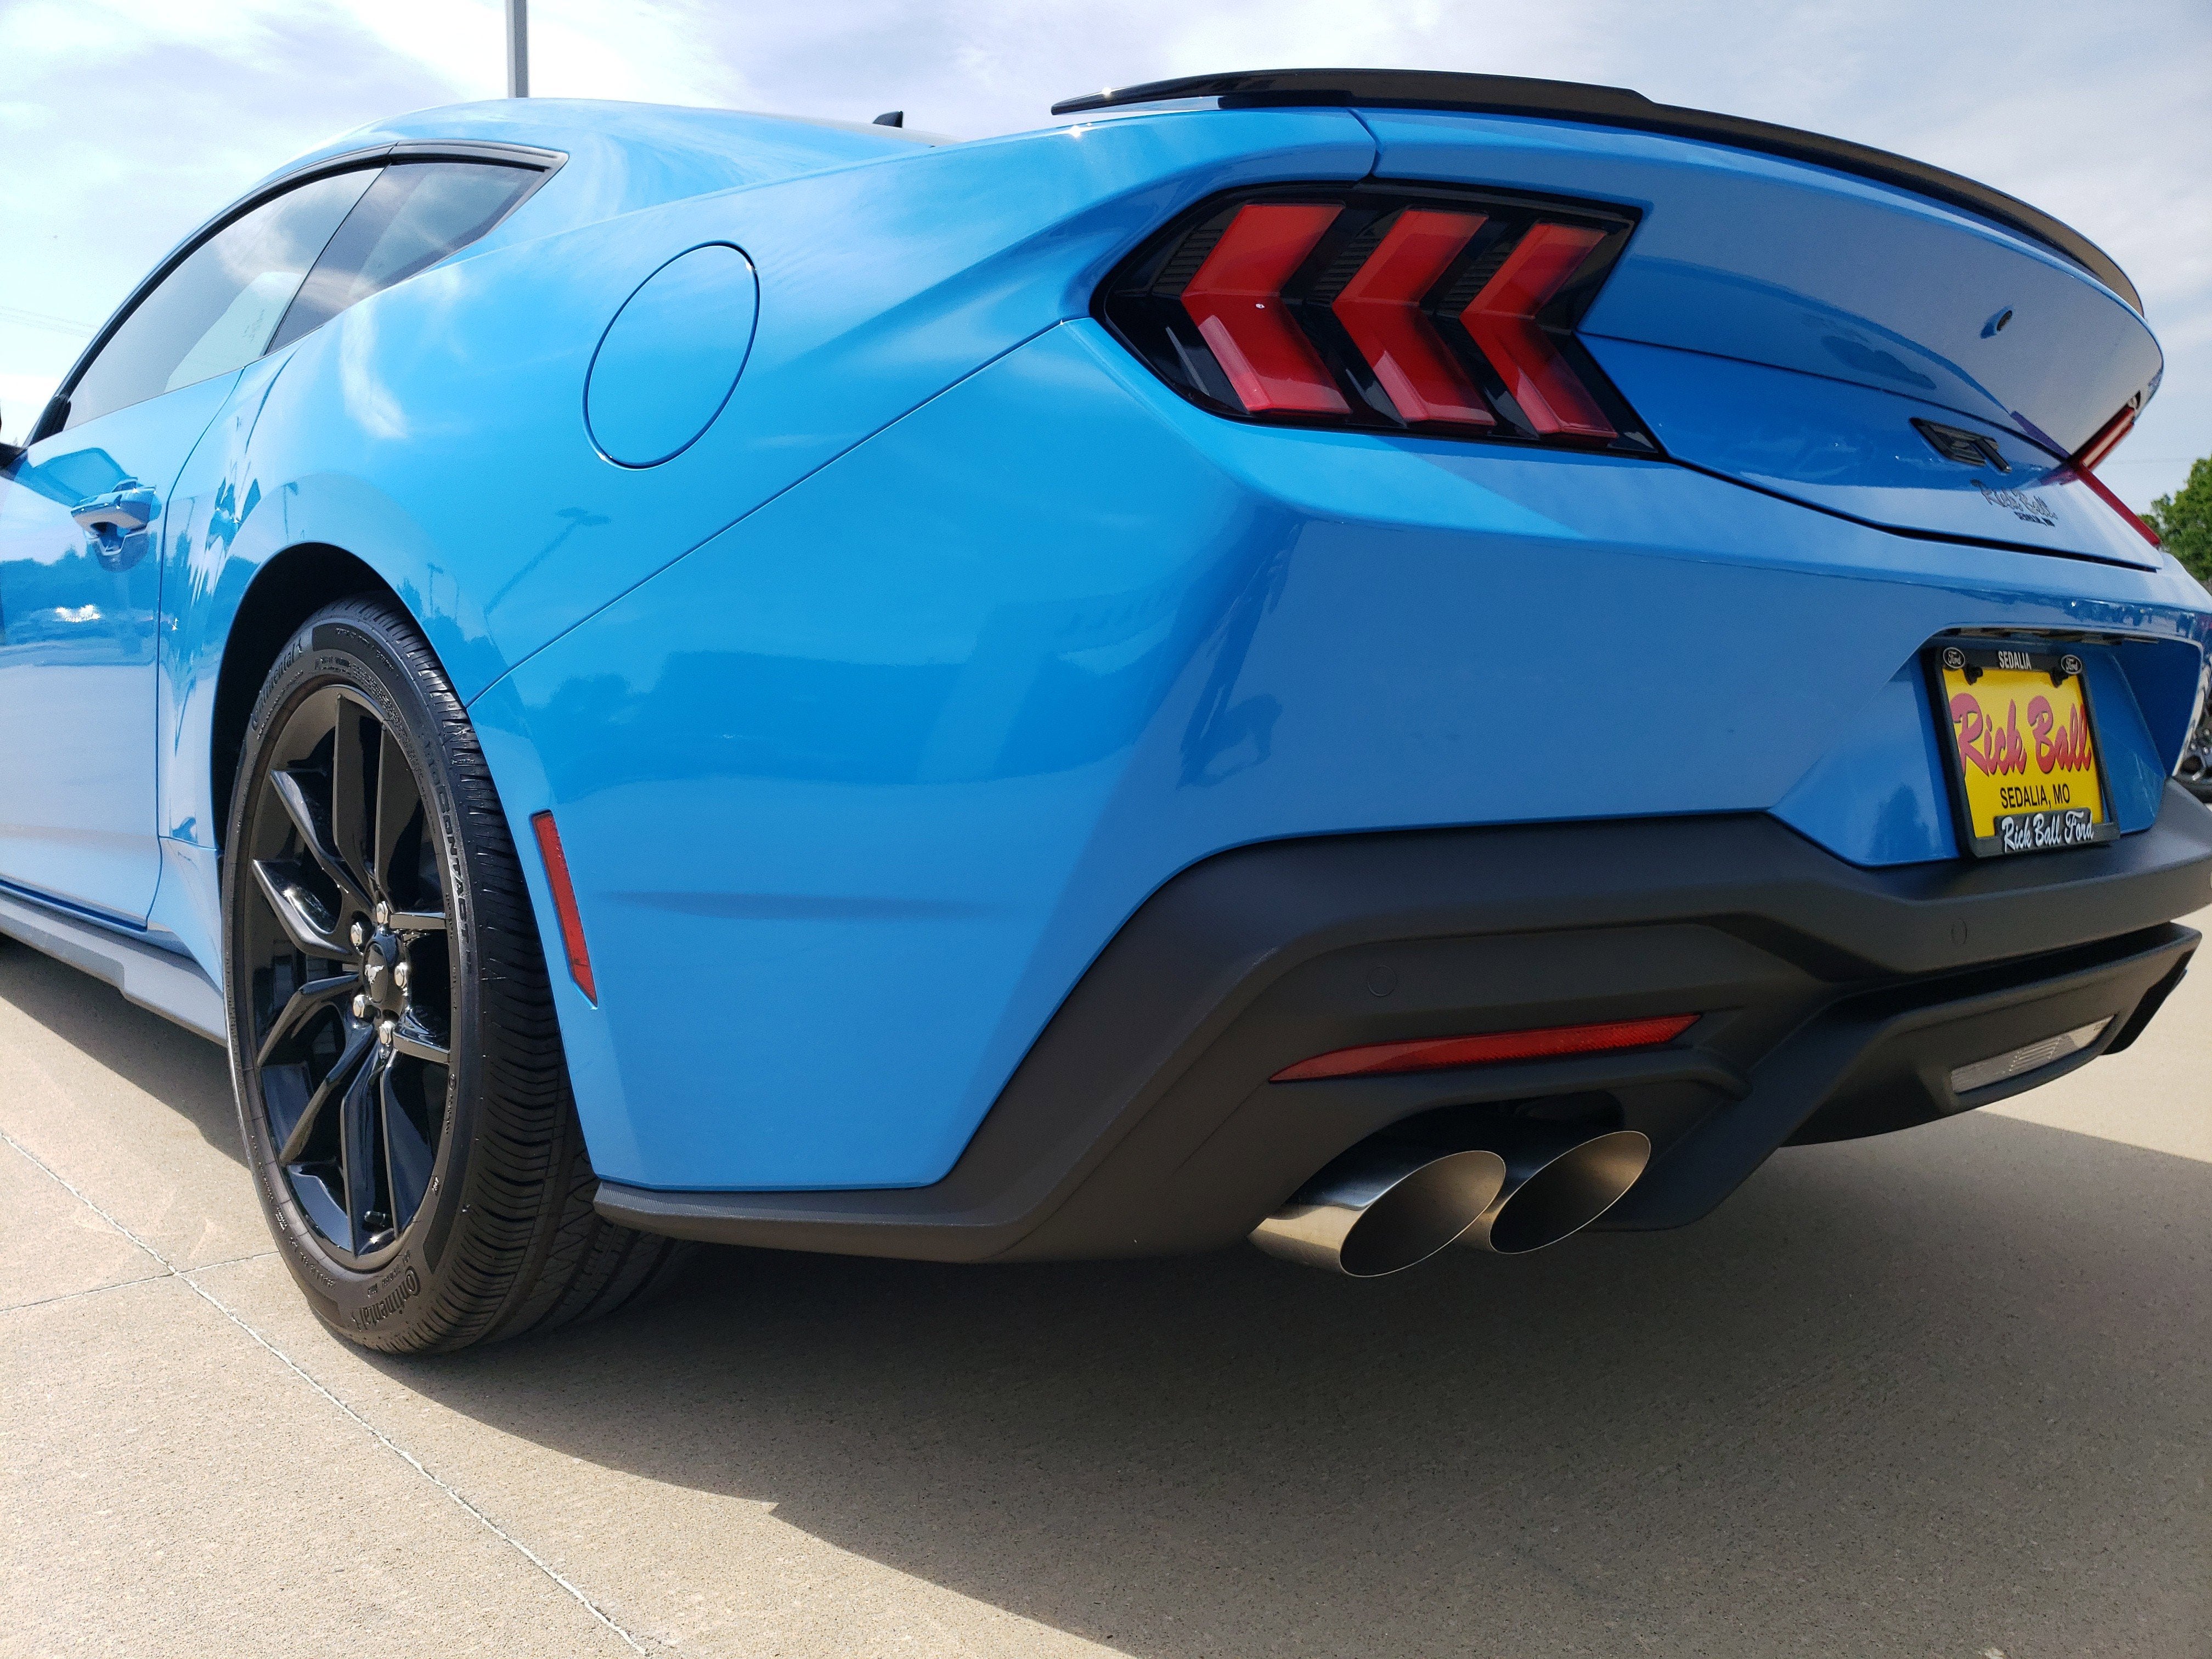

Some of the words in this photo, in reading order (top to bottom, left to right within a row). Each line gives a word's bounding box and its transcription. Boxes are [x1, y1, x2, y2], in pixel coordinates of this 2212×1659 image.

[1997, 650, 2032, 670] SEDALIA
[1949, 692, 2027, 777] Rick
[2027, 695, 2092, 775] Ball
[2000, 785, 2051, 810] SEDALIA,
[2053, 783, 2070, 806] MO
[2001, 816, 2032, 853] Rick
[2034, 812, 2062, 847] Ball
[2064, 810, 2094, 843] Ford
[359, 1265, 421, 1330] Continental
